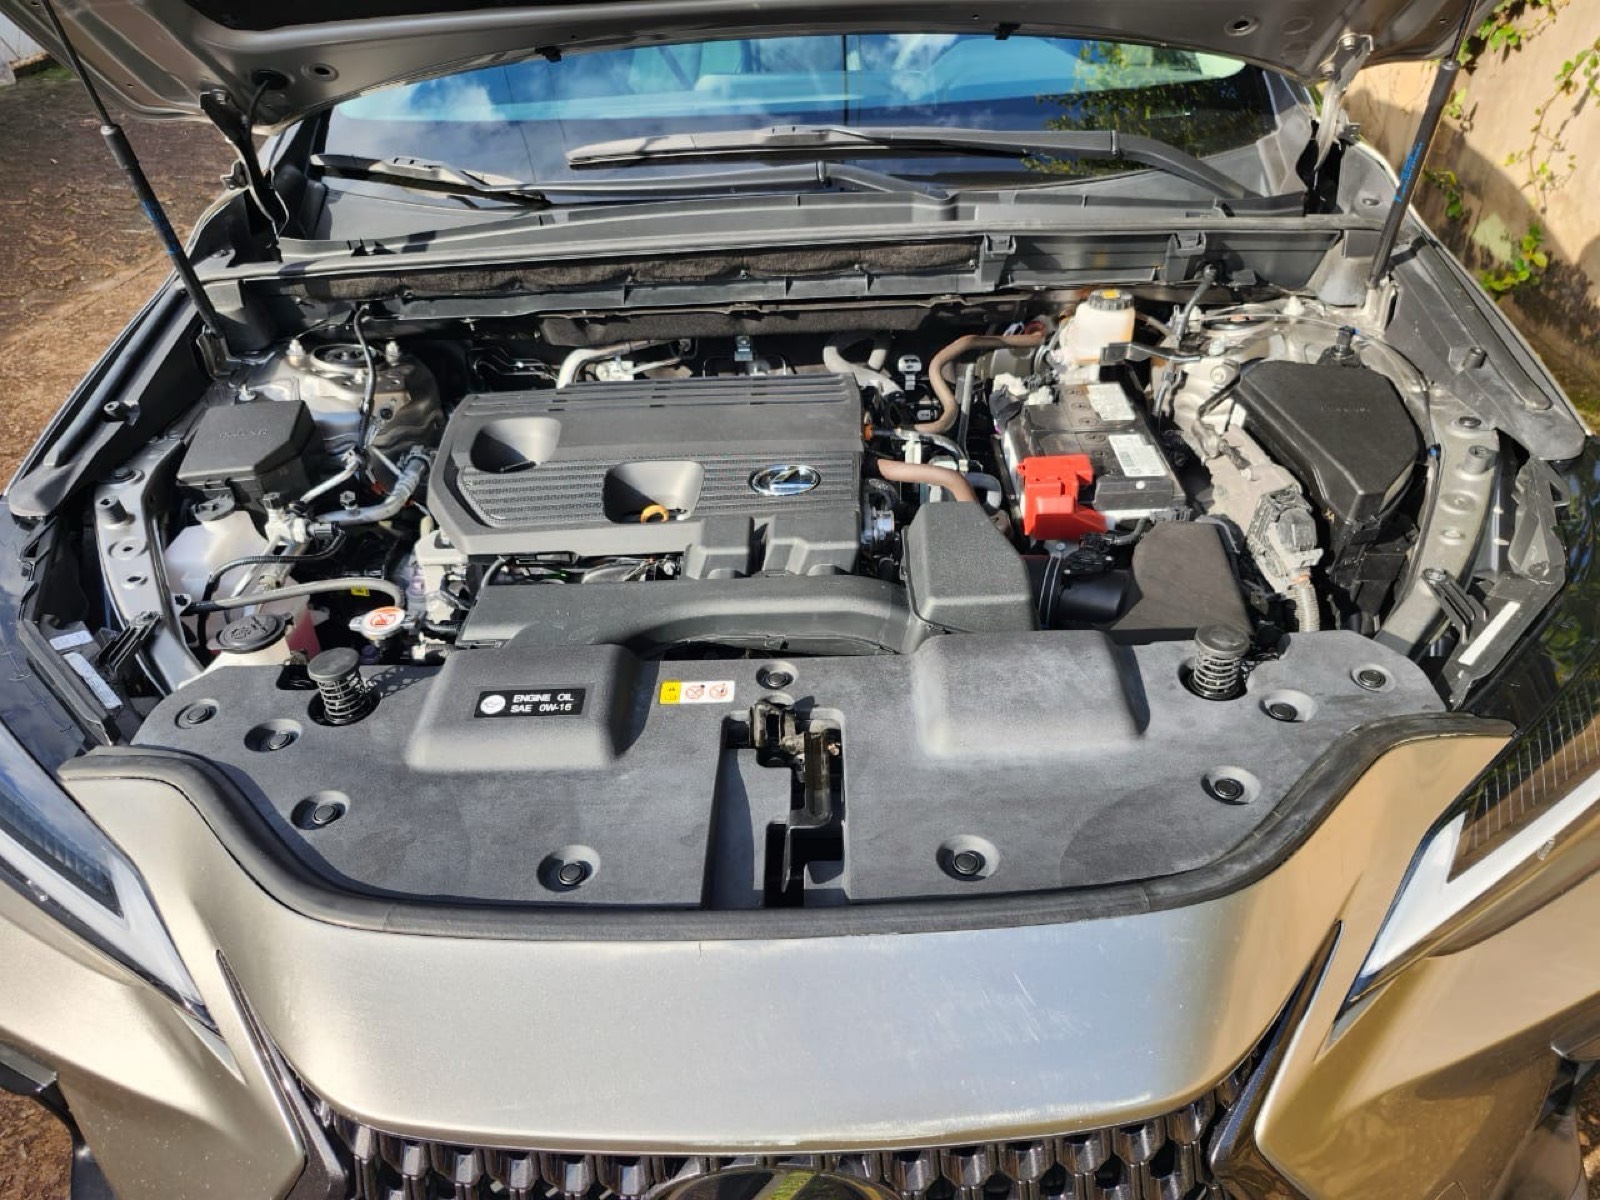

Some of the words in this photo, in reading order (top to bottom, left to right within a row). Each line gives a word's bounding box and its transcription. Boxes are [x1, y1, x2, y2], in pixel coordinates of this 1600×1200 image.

[513, 693, 551, 703] ENGINE
[557, 693, 574, 702] OIL
[510, 704, 533, 713] SAE
